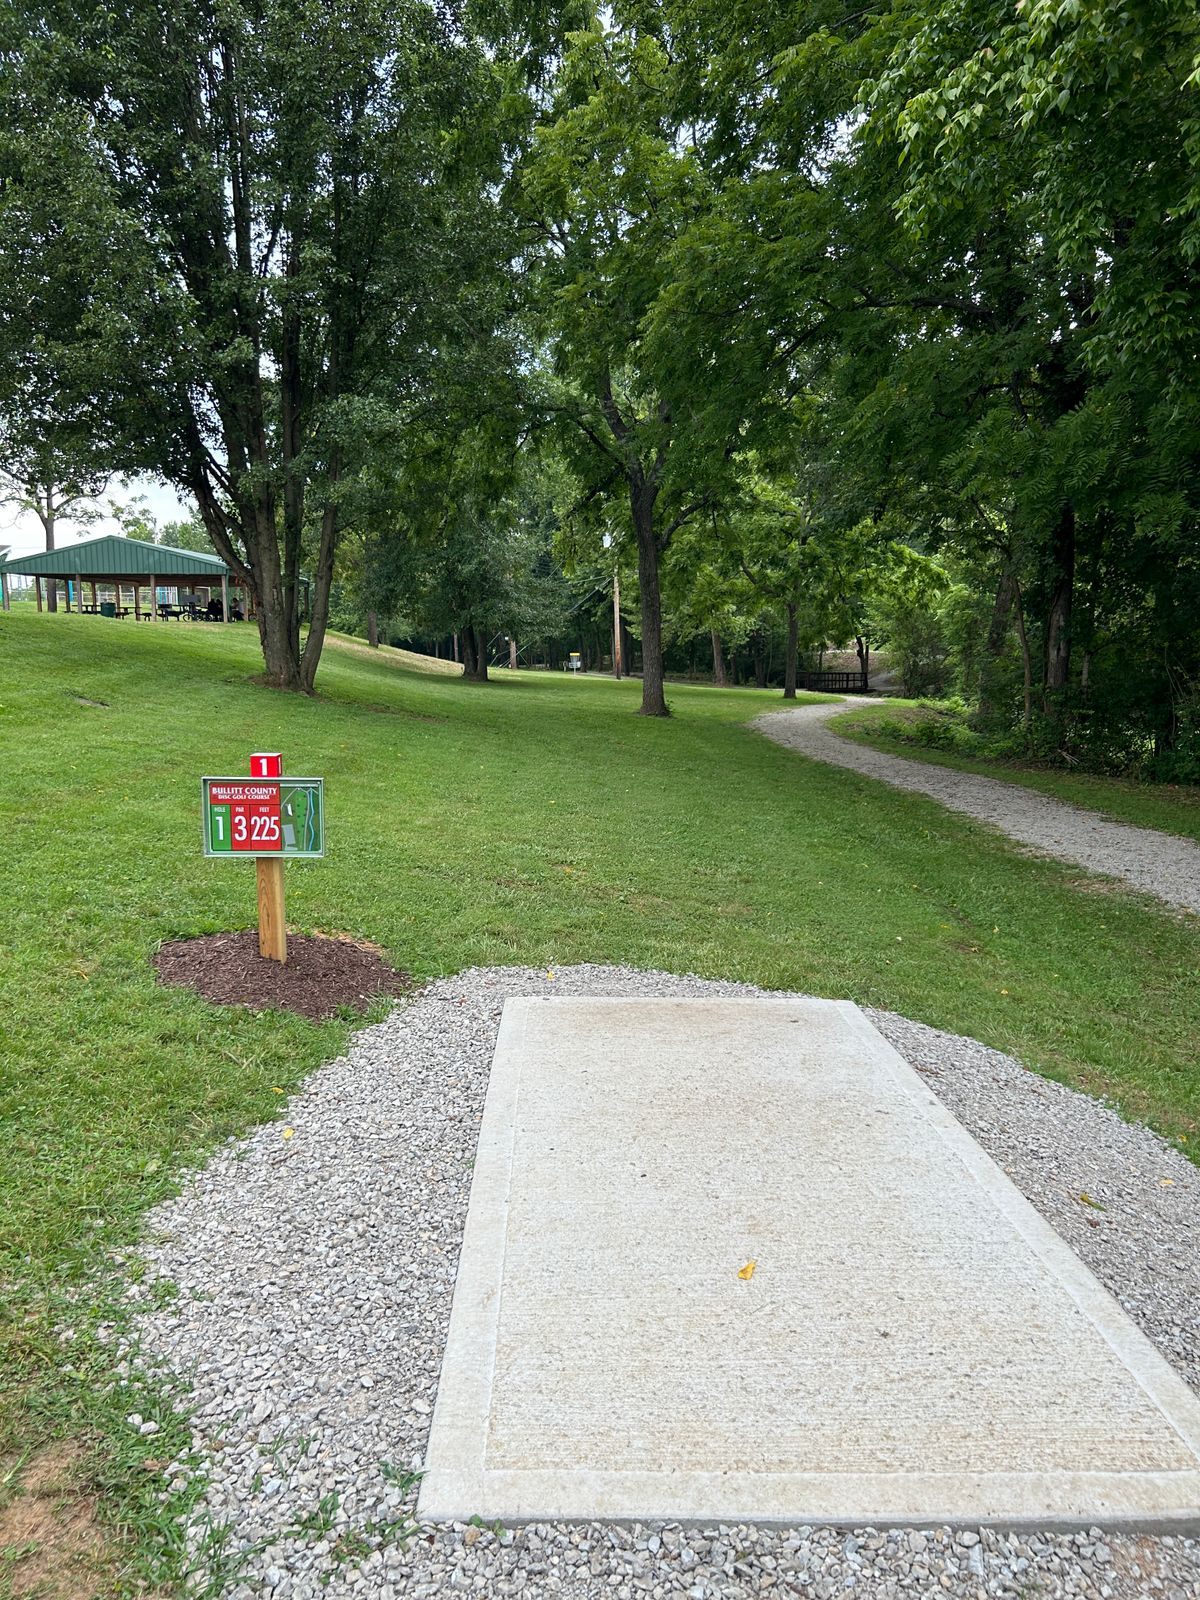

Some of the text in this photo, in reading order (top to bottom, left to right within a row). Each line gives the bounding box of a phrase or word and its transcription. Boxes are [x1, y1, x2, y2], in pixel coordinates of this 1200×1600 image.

[259, 758, 268, 776] 1
[212, 787, 277, 795] BULLITT COUNTY
[215, 815, 280, 841] 1 3 225
